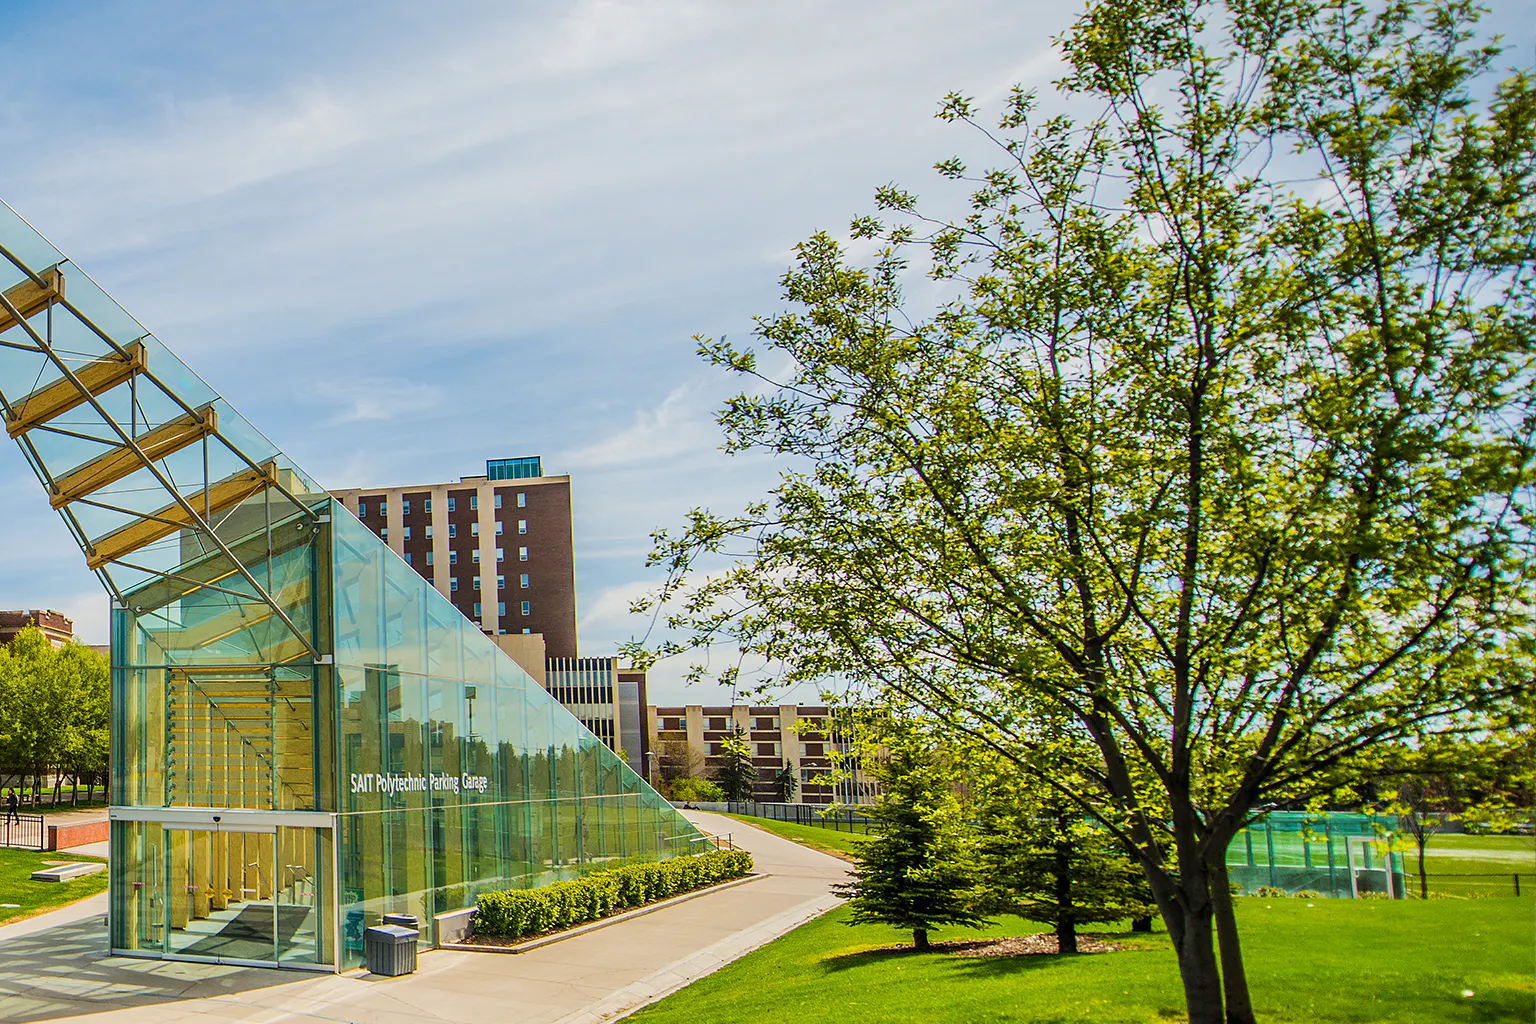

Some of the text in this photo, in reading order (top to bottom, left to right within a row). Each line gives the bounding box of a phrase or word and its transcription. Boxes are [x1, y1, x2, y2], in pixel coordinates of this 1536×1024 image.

[350, 772, 488, 797] SAIT Polytechnic Parking Garage
